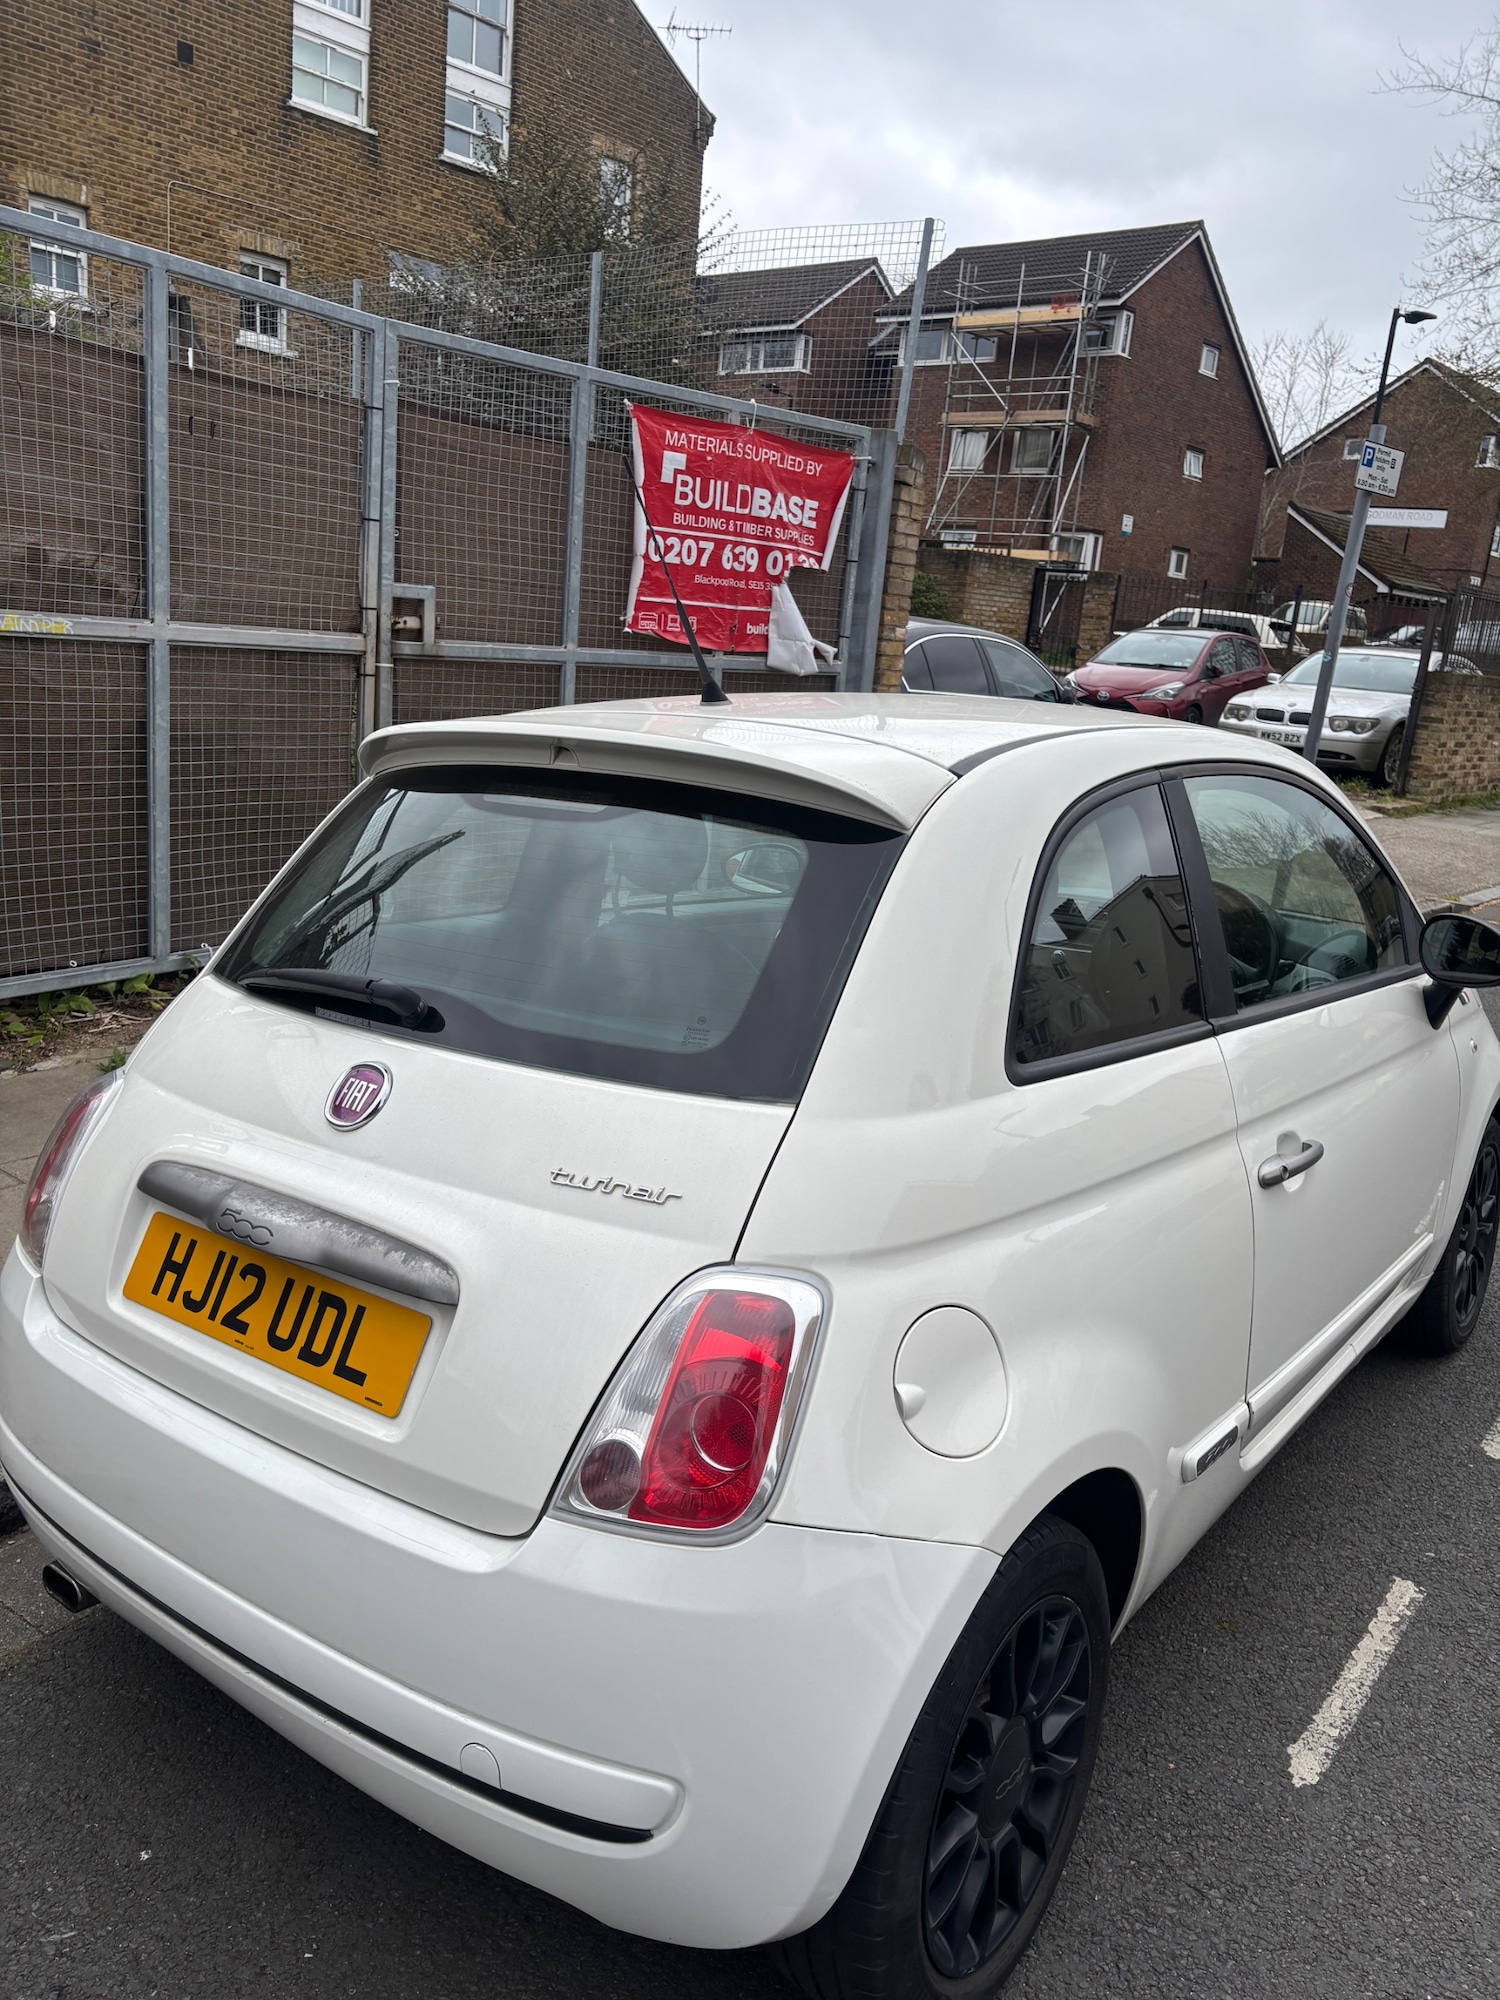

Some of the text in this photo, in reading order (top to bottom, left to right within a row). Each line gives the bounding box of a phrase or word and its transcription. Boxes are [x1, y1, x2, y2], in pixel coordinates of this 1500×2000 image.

[665, 430, 823, 477] MATERIALS SUPPLIED BY
[1363, 448, 1374, 465] P
[1375, 456, 1390, 465] holders
[1378, 448, 1391, 457] Permit
[1368, 473, 1378, 481] Mon
[674, 474, 819, 530] BUILDBASE
[1406, 511, 1433, 521] ROAD
[673, 512, 726, 530] BUILDING
[728, 520, 735, 532] &
[775, 527, 815, 547] SUPPLIES
[648, 534, 715, 567] 0207
[721, 543, 759, 573] 639
[335, 1077, 378, 1113] FIAT
[550, 1167, 683, 1205] twinair
[216, 1207, 274, 1247] 500
[151, 1232, 368, 1387] HJ12 UDL
